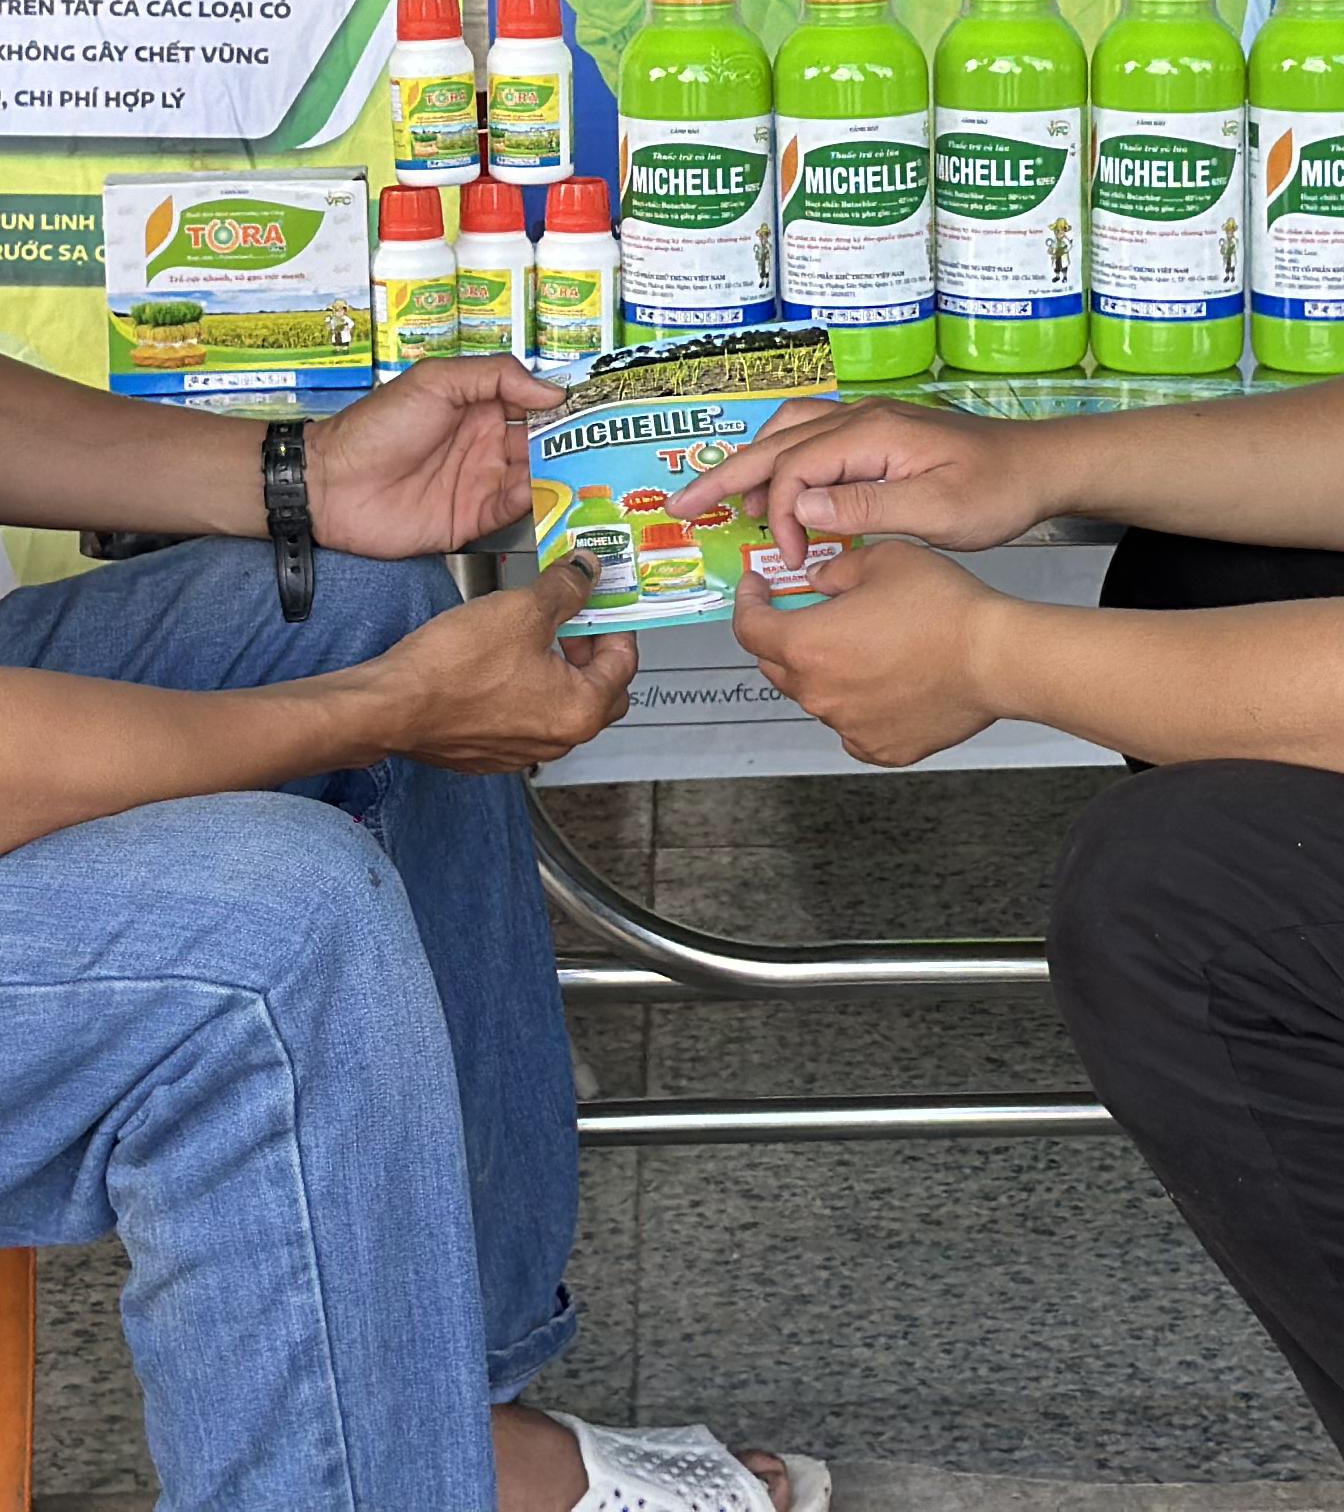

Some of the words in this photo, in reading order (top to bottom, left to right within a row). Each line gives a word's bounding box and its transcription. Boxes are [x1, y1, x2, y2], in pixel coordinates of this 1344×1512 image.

[199, 1, 253, 23] LOẠI
[82, 41, 128, 62] GÂY
[135, 40, 195, 63] CHẾT
[201, 43, 269, 64] VŨNG
[15, 90, 52, 107] CHI
[60, 86, 99, 107] PHÍ
[105, 89, 155, 112] HỢP
[162, 88, 186, 108] LÝ
[425, 89, 467, 106] TORA
[632, 164, 744, 196] MICHELLE
[805, 160, 917, 195] MICHELLE
[1100, 155, 1210, 188] MICHELLE
[40, 214, 95, 231] LINH
[185, 219, 286, 254] TORA
[58, 245, 88, 265] SẠ
[630, 682, 783, 707] s://www.vfc.co
